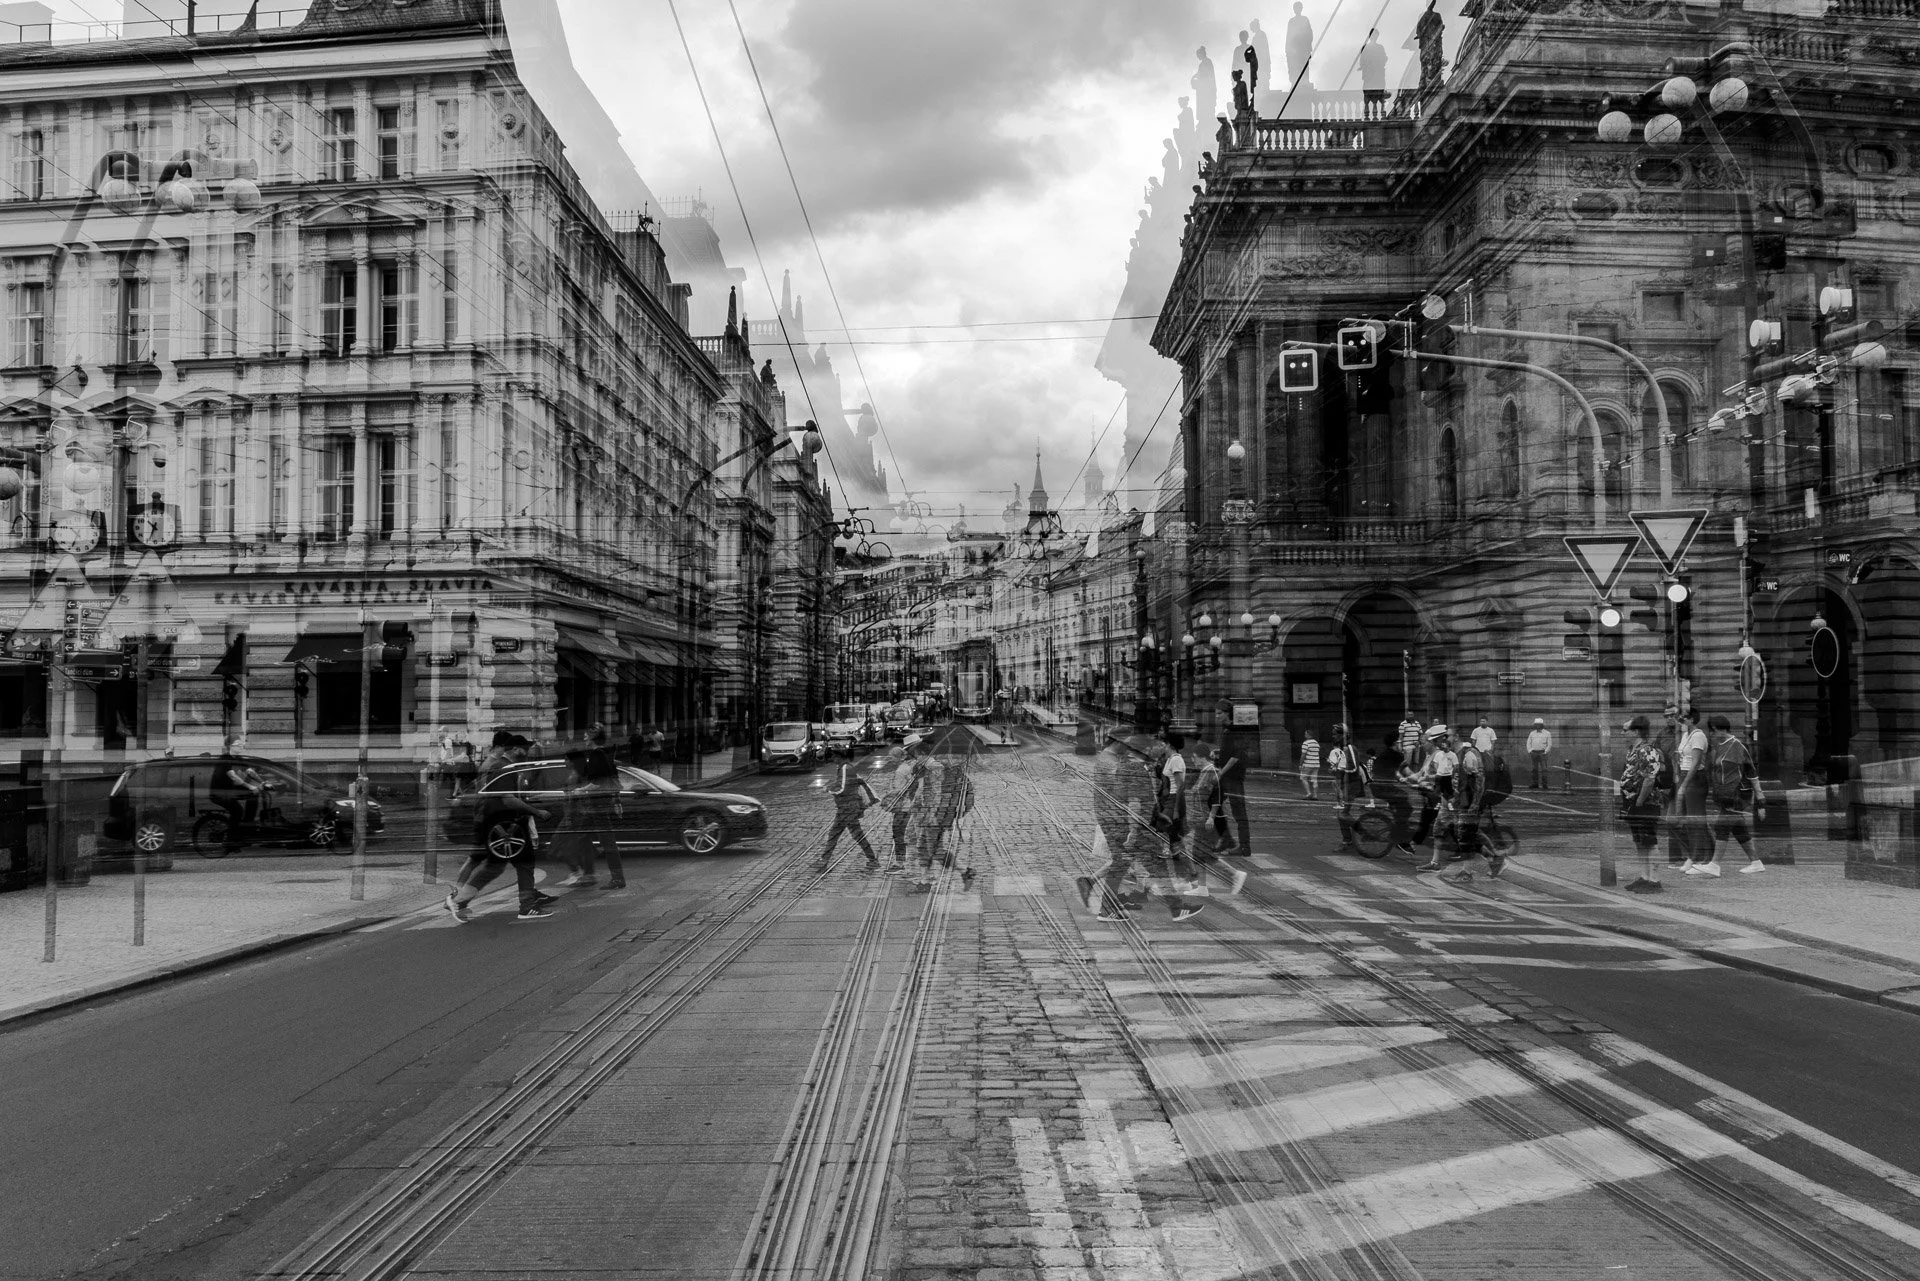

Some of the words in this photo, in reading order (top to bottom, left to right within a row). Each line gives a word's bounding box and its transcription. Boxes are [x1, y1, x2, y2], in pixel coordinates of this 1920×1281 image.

[1839, 553, 1851, 562] WC
[409, 579, 493, 591] SLAVIA
[1766, 581, 1778, 590] WC
